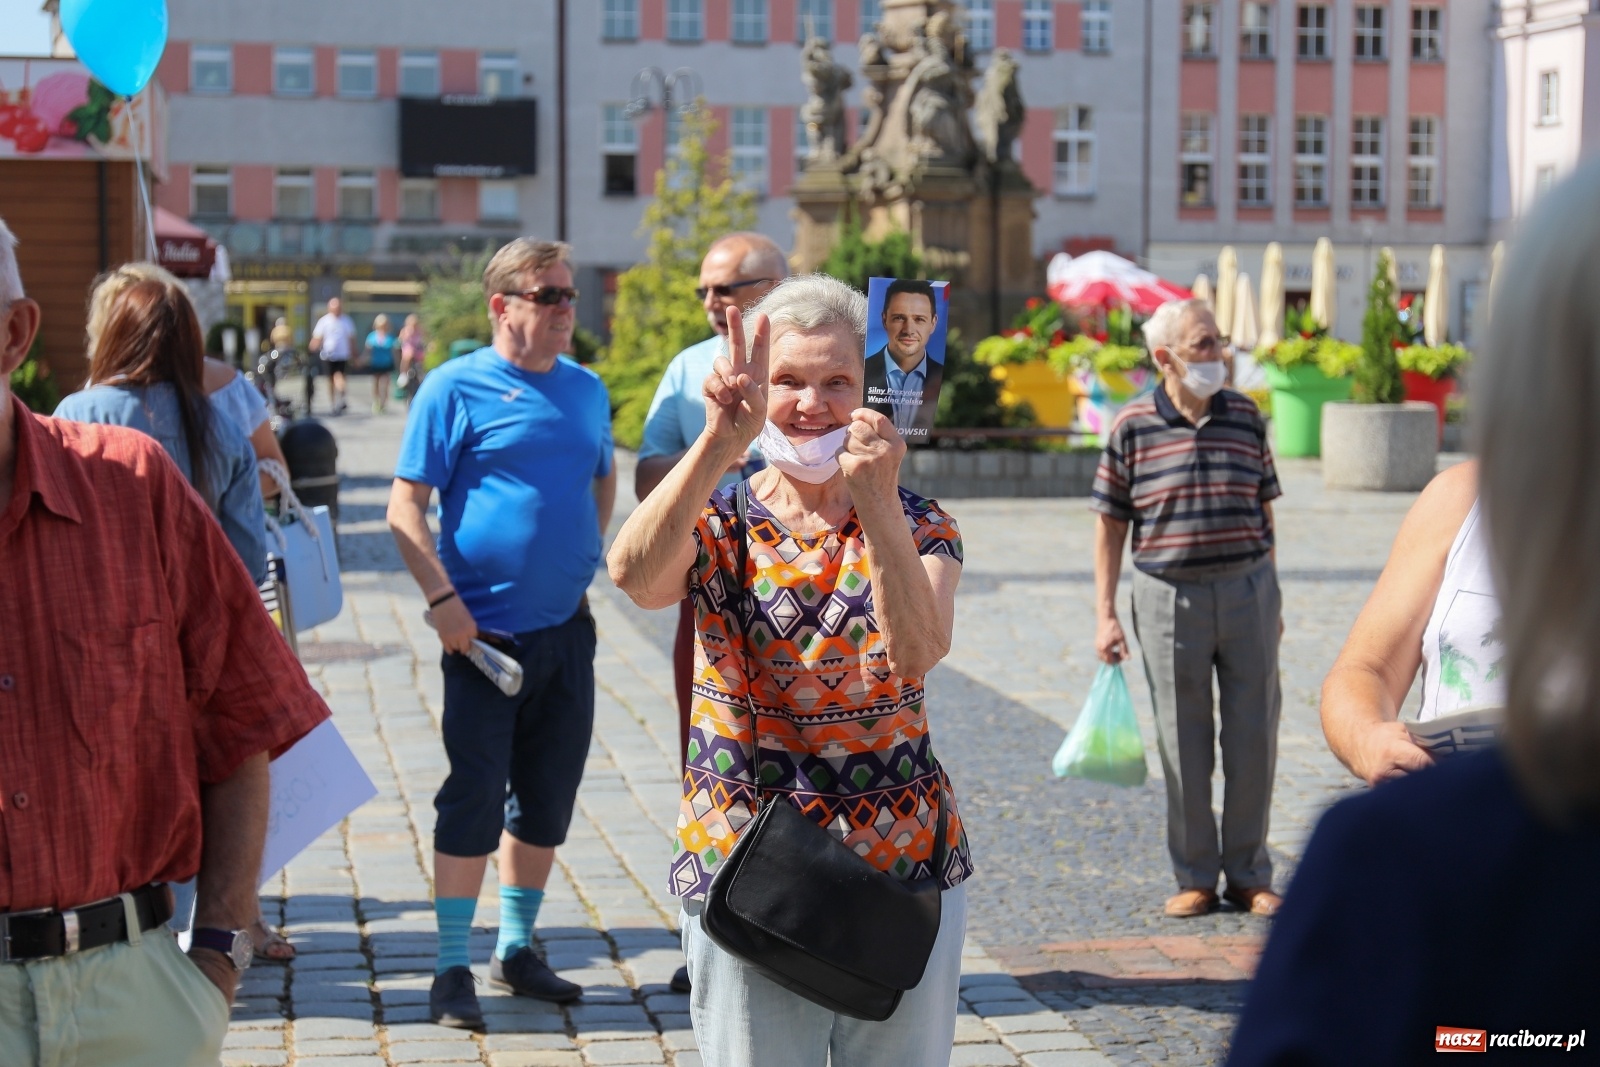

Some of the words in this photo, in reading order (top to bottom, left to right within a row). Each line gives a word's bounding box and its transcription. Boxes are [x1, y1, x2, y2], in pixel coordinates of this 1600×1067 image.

[868, 386, 886, 395] Silny
[887, 388, 924, 397] Prezydent
[867, 395, 899, 404] Wspólna
[901, 397, 924, 405] Polska
[895, 428, 928, 436] OWSKI
